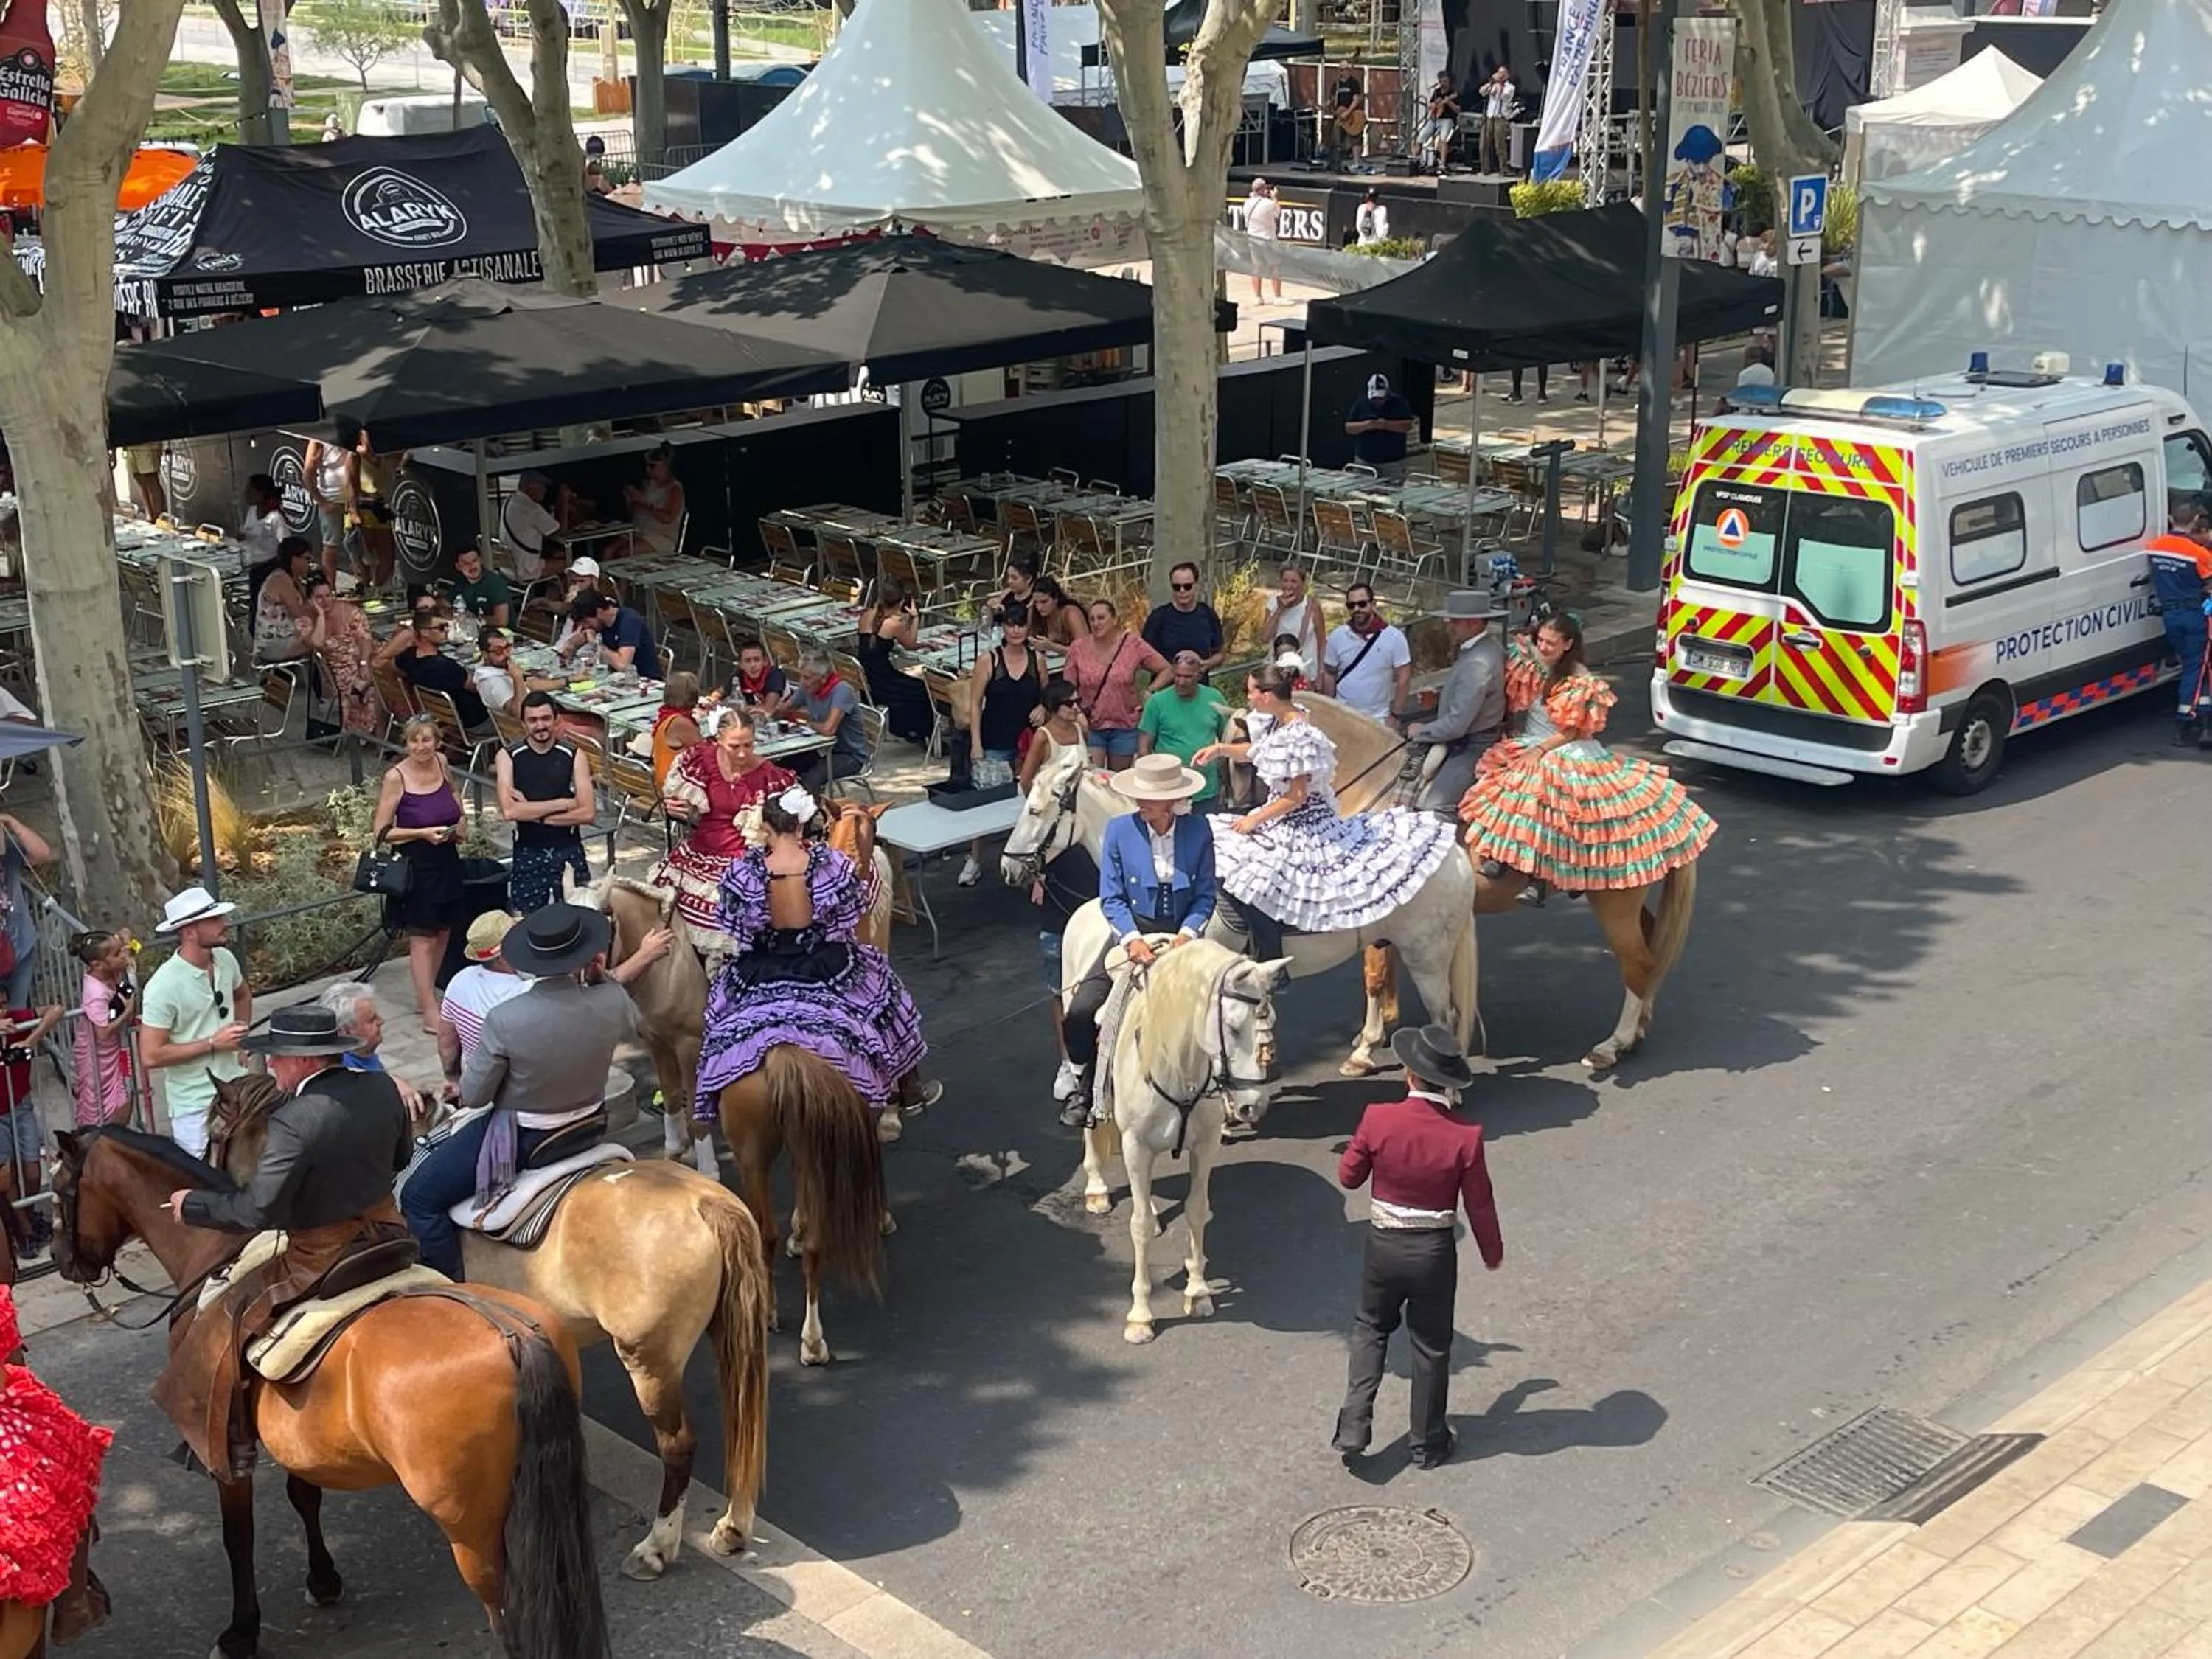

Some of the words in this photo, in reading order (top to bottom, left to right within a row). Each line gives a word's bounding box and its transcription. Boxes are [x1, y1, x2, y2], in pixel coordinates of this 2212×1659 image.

[1685, 38, 1722, 66] FERIA
[0, 66, 51, 92] Estrella
[1676, 70, 1728, 100] BÉZIERS
[0, 82, 48, 107] Galicia
[359, 202, 459, 231] ALARYK
[1800, 188, 1816, 224] P
[364, 261, 446, 294] BRASSERIE
[1990, 451, 2003, 468] DE
[2005, 441, 2049, 465] PREMIERS
[2050, 432, 2092, 454] SECOURS
[2101, 419, 2151, 442] PERSONNES
[394, 517, 438, 543] ALARYK
[1996, 612, 2103, 664] PROTECTION
[2107, 594, 2157, 629] CIVILE
